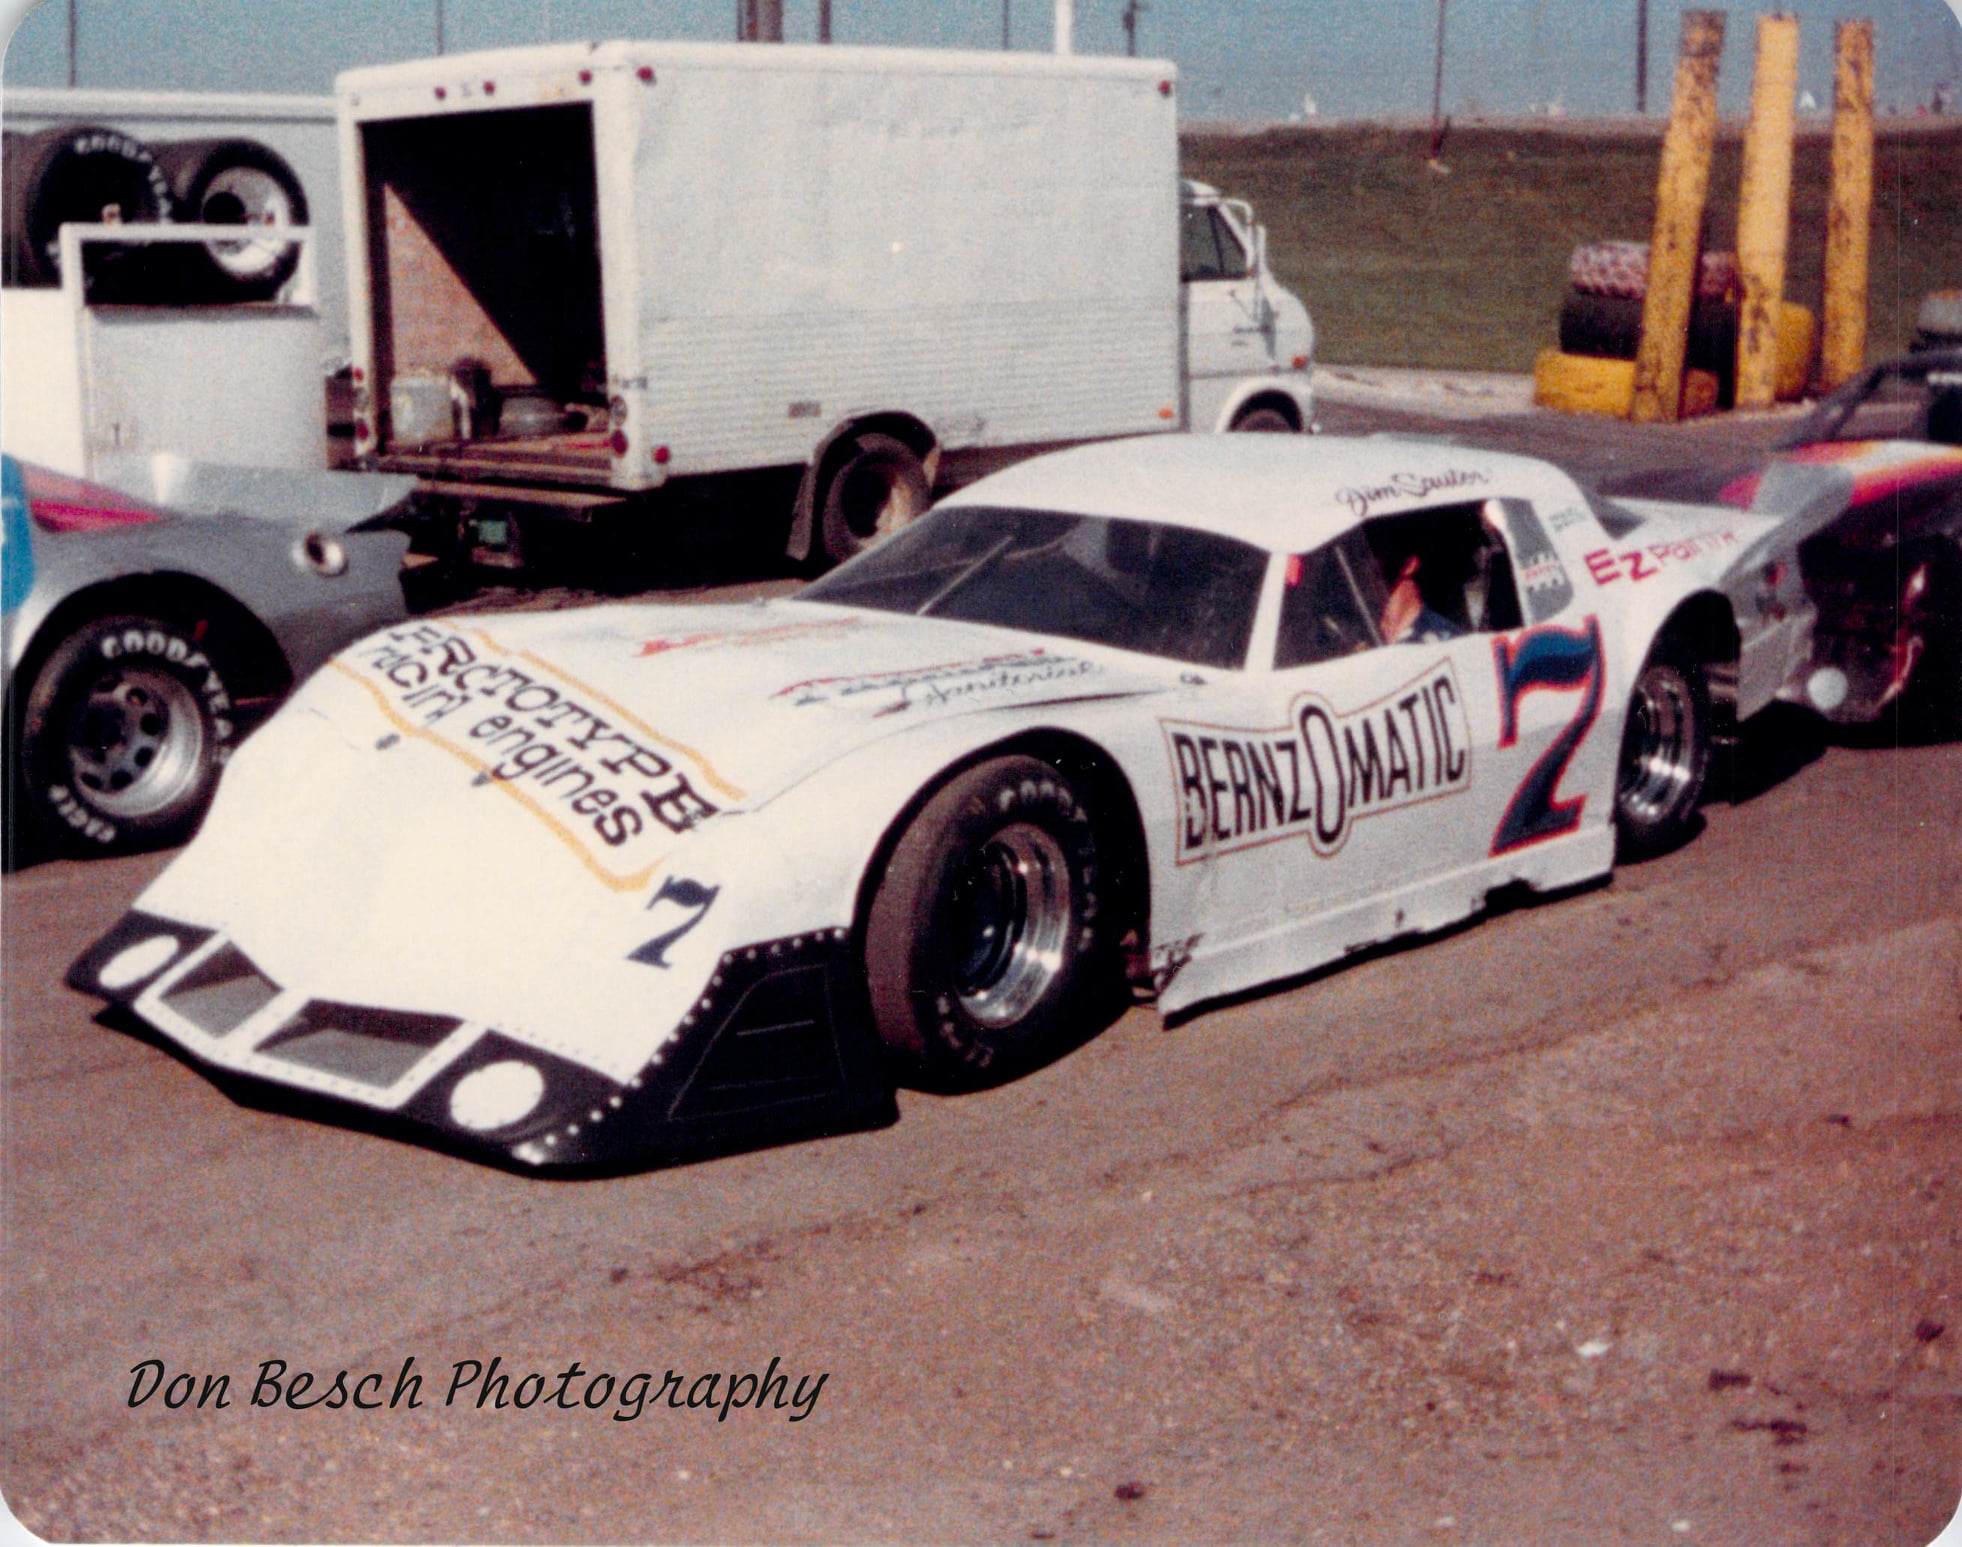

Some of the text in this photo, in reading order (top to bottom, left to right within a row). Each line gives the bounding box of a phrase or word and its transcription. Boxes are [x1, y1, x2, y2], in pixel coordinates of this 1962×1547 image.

[1334, 483, 1400, 517] Jim
[1584, 547, 1659, 587] EZ
[469, 714, 644, 847] engines
[1171, 675, 1467, 845] BERNZOMATIC
[1489, 613, 1606, 858] 7
[625, 874, 721, 970] 7
